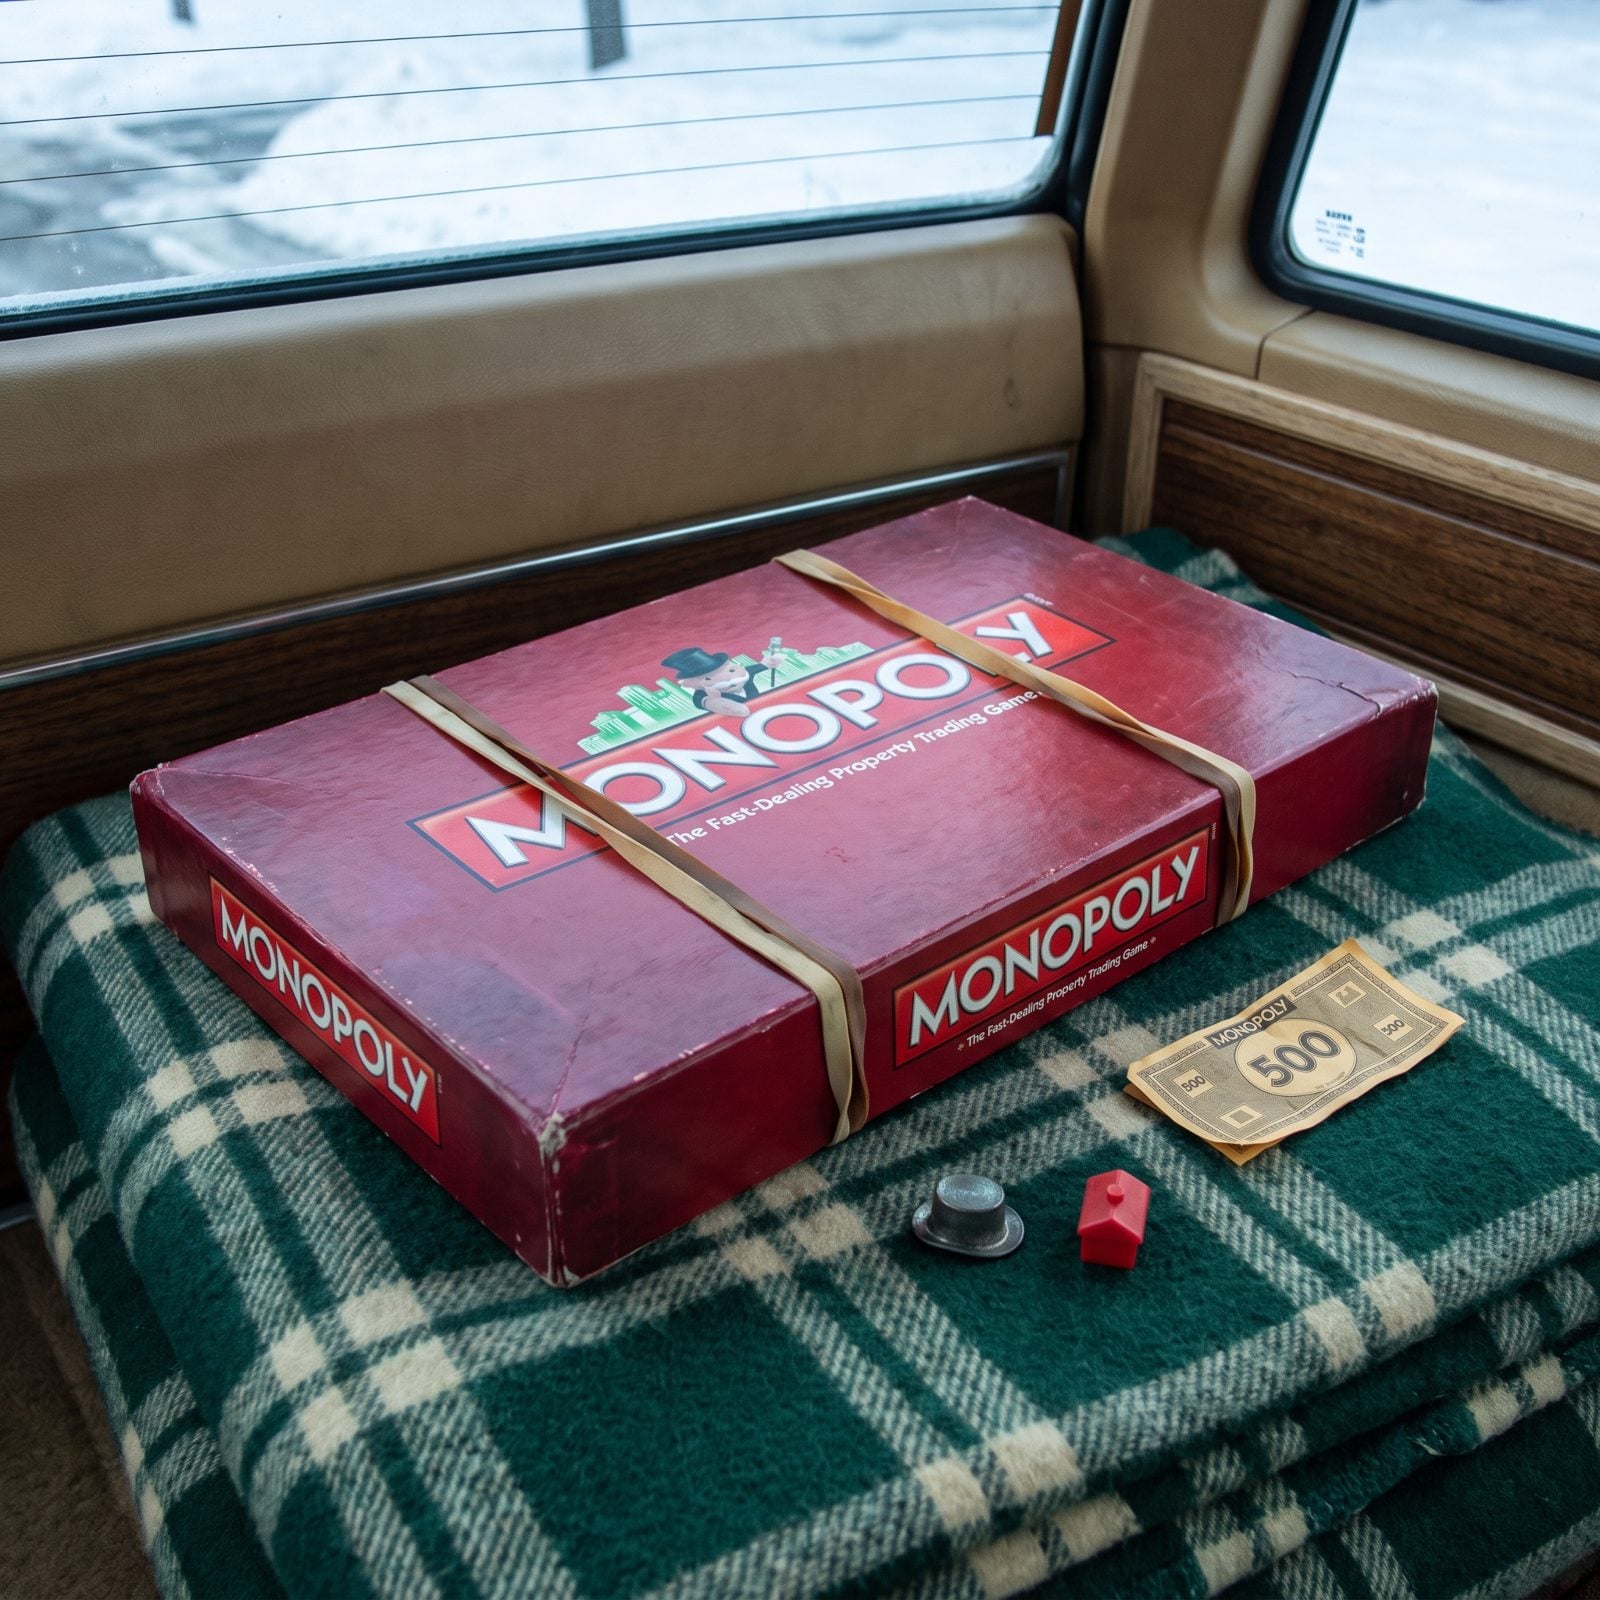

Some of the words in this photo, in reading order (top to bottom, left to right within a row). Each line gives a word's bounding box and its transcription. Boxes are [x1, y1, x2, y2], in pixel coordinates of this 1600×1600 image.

[464, 610, 1054, 869] MONOPOY
[705, 775, 835, 831] Fast-Dealing
[828, 738, 918, 780] Property
[913, 712, 988, 745] Trading
[220, 893, 429, 1114] MONOPOLY
[909, 846, 1200, 1048] MONOPOLY
[966, 1031, 986, 1047] The
[986, 997, 1046, 1037] Fast-Dealing
[1046, 974, 1087, 1004] Property
[1088, 955, 1121, 980] Trading
[1122, 940, 1149, 961] Game
[1210, 999, 1288, 1046] MONOPOLY
[1246, 1029, 1341, 1088] 500
[1381, 1019, 1405, 1036] 500
